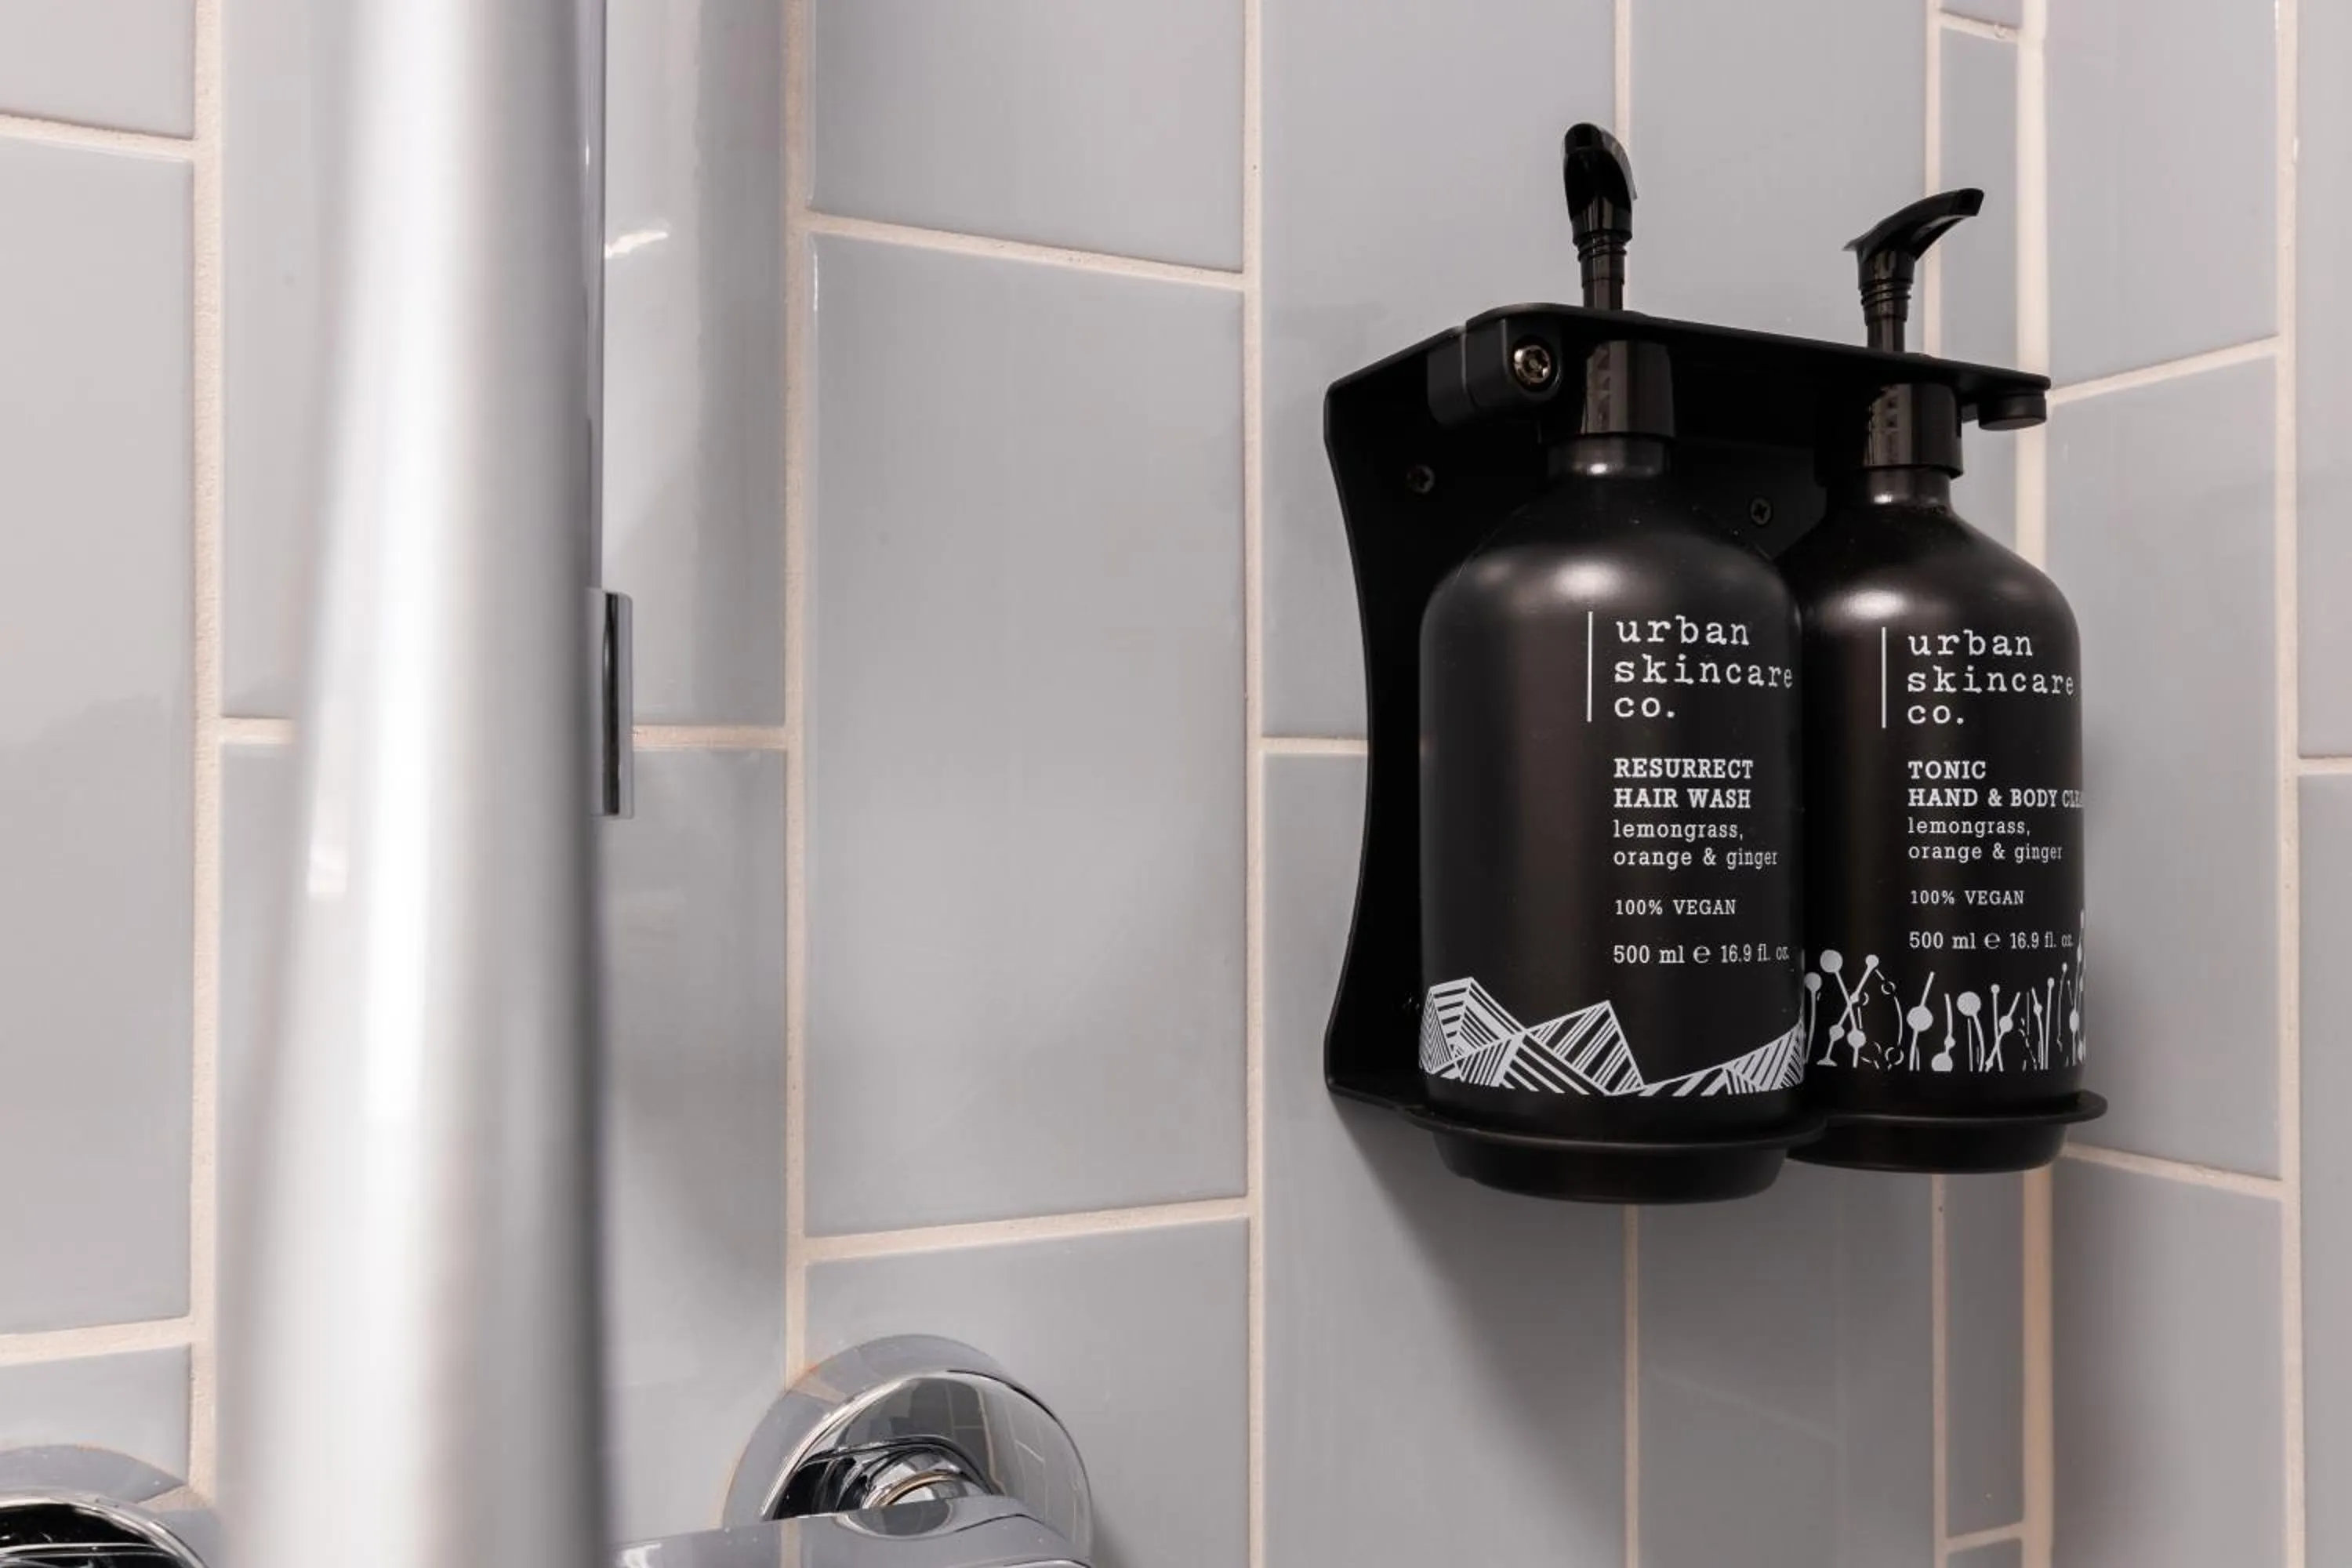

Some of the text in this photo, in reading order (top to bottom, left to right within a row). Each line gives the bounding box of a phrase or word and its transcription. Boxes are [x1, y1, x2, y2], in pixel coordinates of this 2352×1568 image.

[1615, 614, 1750, 646] urban
[1907, 628, 2034, 657] urban
[1613, 652, 1793, 689] skincare
[1907, 664, 2074, 697] skincare
[1613, 696, 1675, 718] co.
[1907, 704, 1964, 725] co.
[1613, 757, 1754, 779] RESURRECT
[1907, 760, 1986, 780] TONIC
[1613, 787, 1751, 809] HAIR WASH
[1907, 788, 1978, 808] HAND
[1987, 787, 2003, 808] &
[2009, 788, 2058, 808] BODY
[1613, 818, 1744, 843] lemongrass,
[1907, 816, 2031, 839] lemongrass,
[1613, 847, 1778, 871] orange & ginger
[1907, 841, 2062, 864] orange & ginger
[1615, 898, 1737, 916] 100% VEGAN
[1911, 889, 2024, 906] 100% VEGAN
[1909, 931, 1944, 949] 500
[1951, 932, 1976, 949] ml
[2009, 931, 2039, 949] 16.9
[1613, 945, 1650, 964] 500
[1658, 945, 1686, 964] ml
[1720, 943, 1752, 964] 16.9
